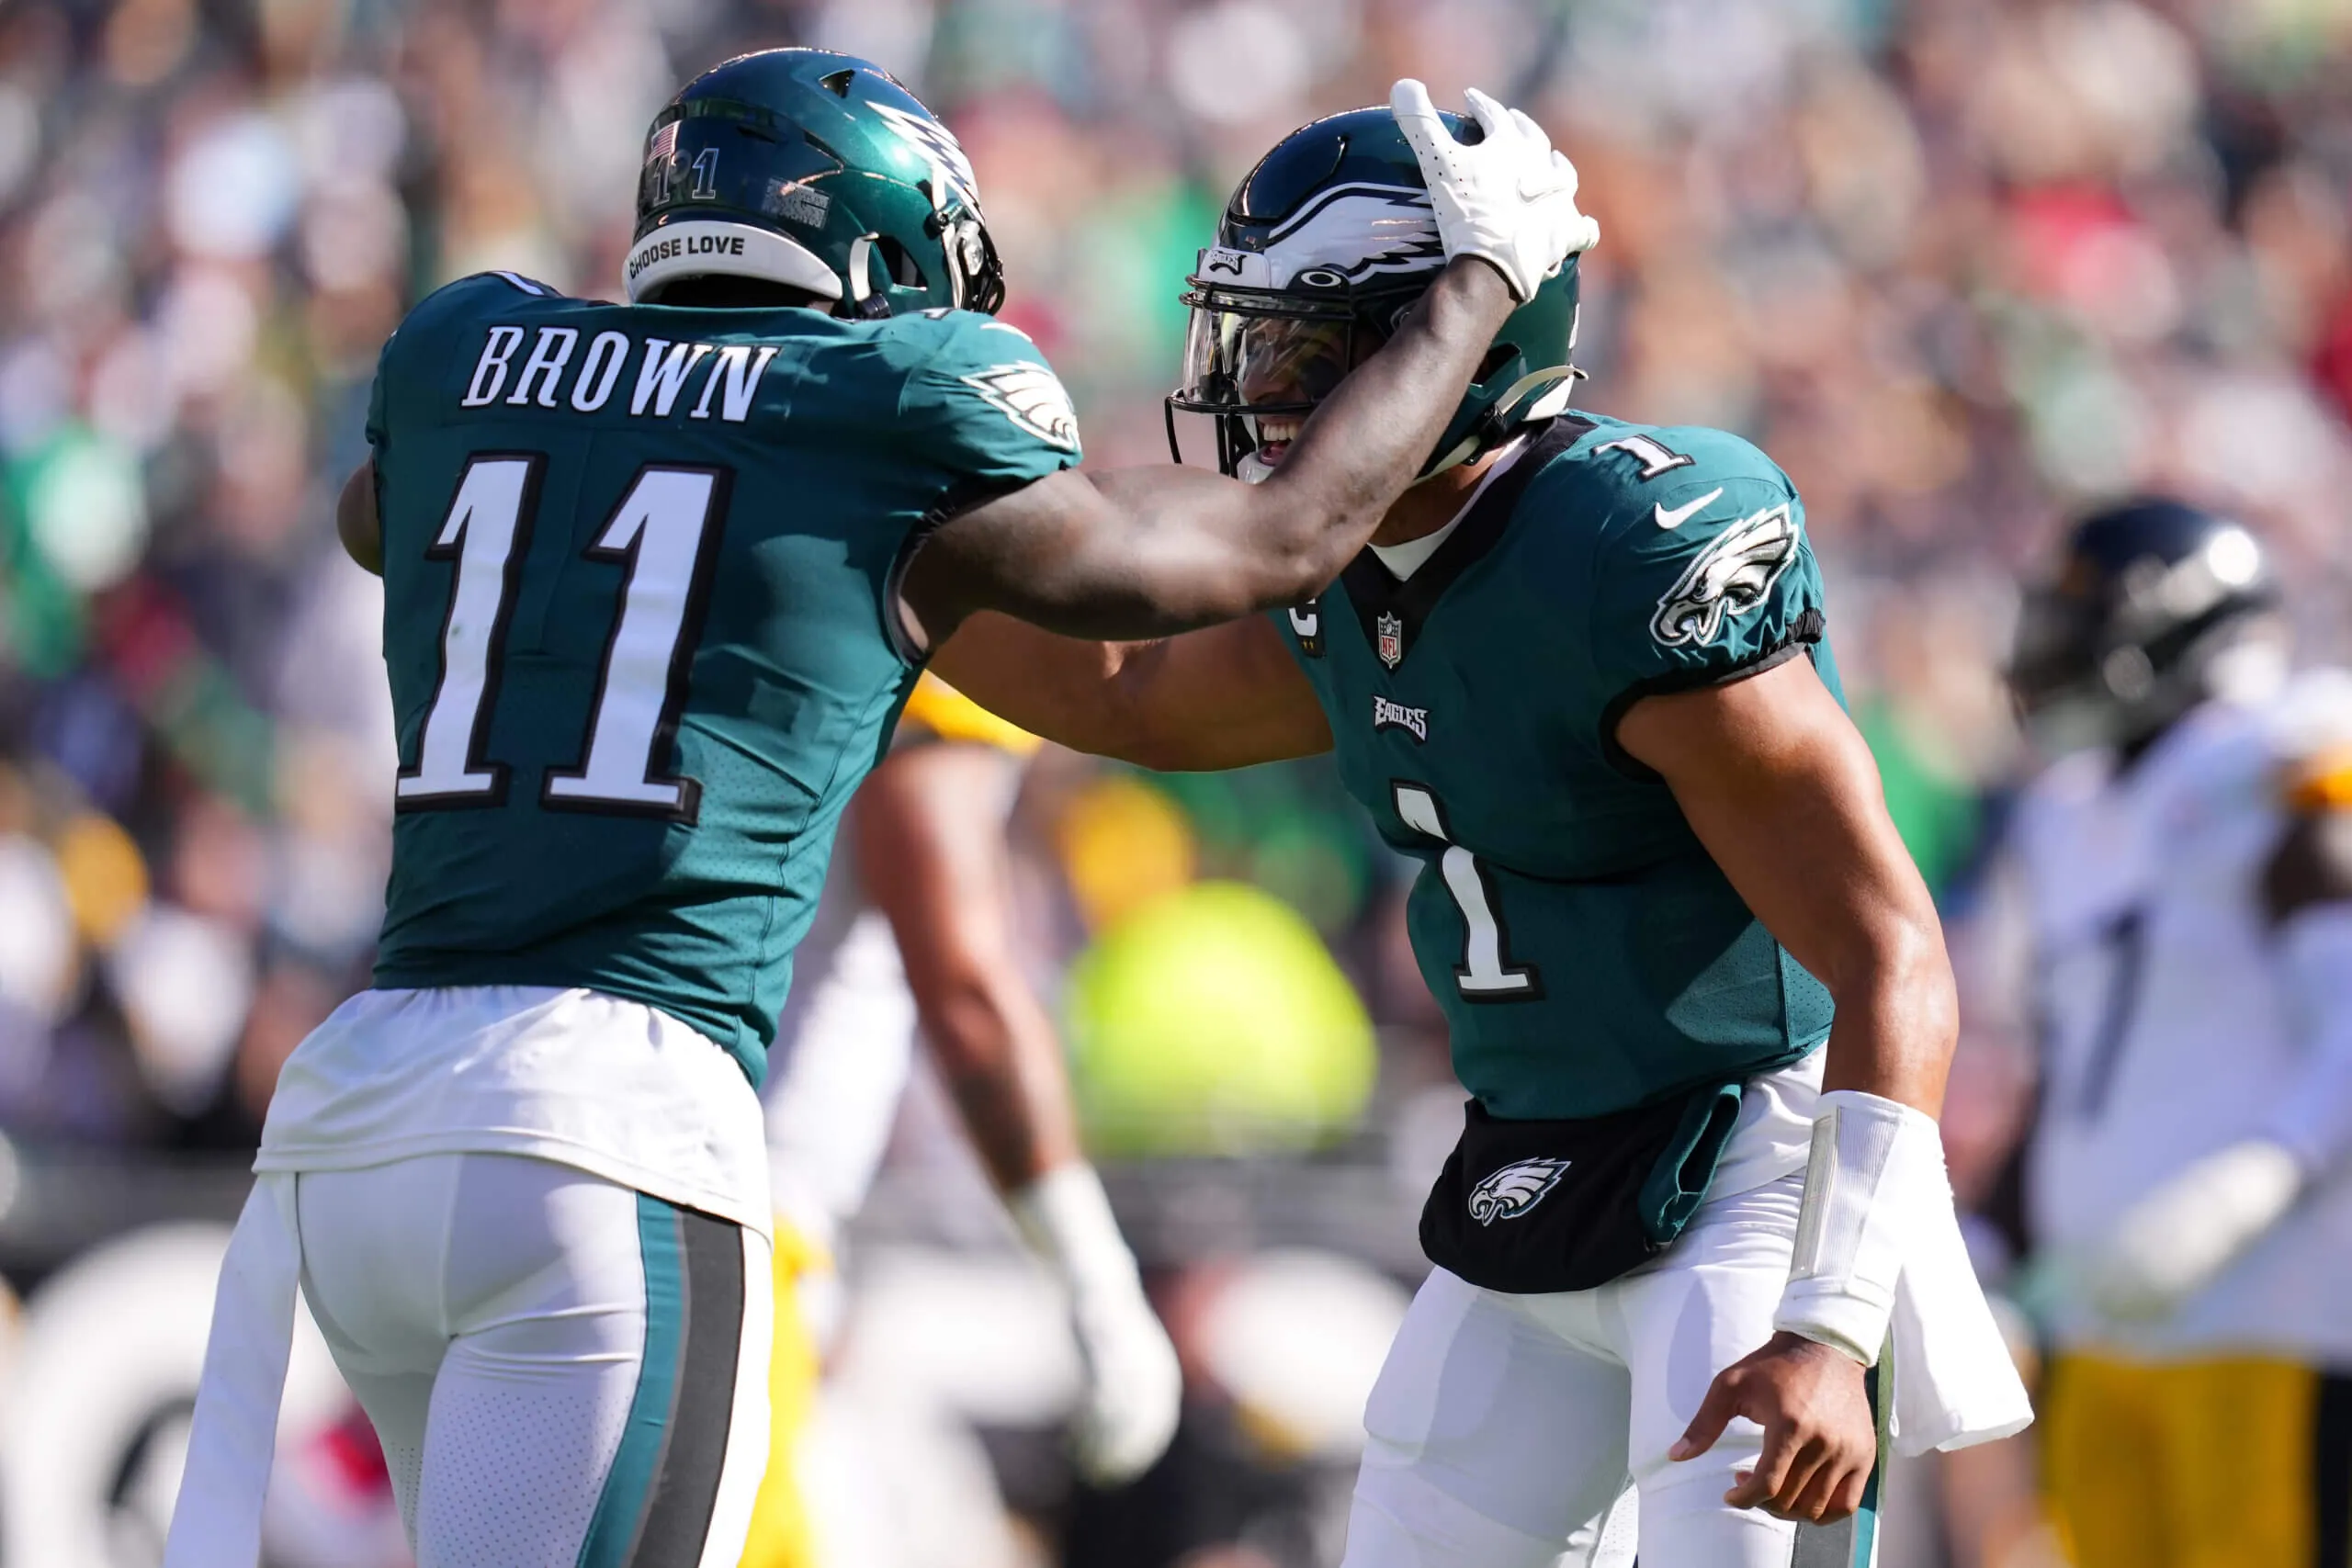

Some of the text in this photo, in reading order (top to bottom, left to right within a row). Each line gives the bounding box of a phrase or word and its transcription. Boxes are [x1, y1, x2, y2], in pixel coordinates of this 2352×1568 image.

[628, 234, 745, 279] CHOOSE LOVE
[461, 324, 779, 423] BROWN
[1590, 434, 1696, 484] 1
[395, 451, 735, 825] 11
[1381, 636, 1397, 659] NFL
[1374, 695, 1428, 741] EAGLES
[1392, 780, 1542, 1000] 1
